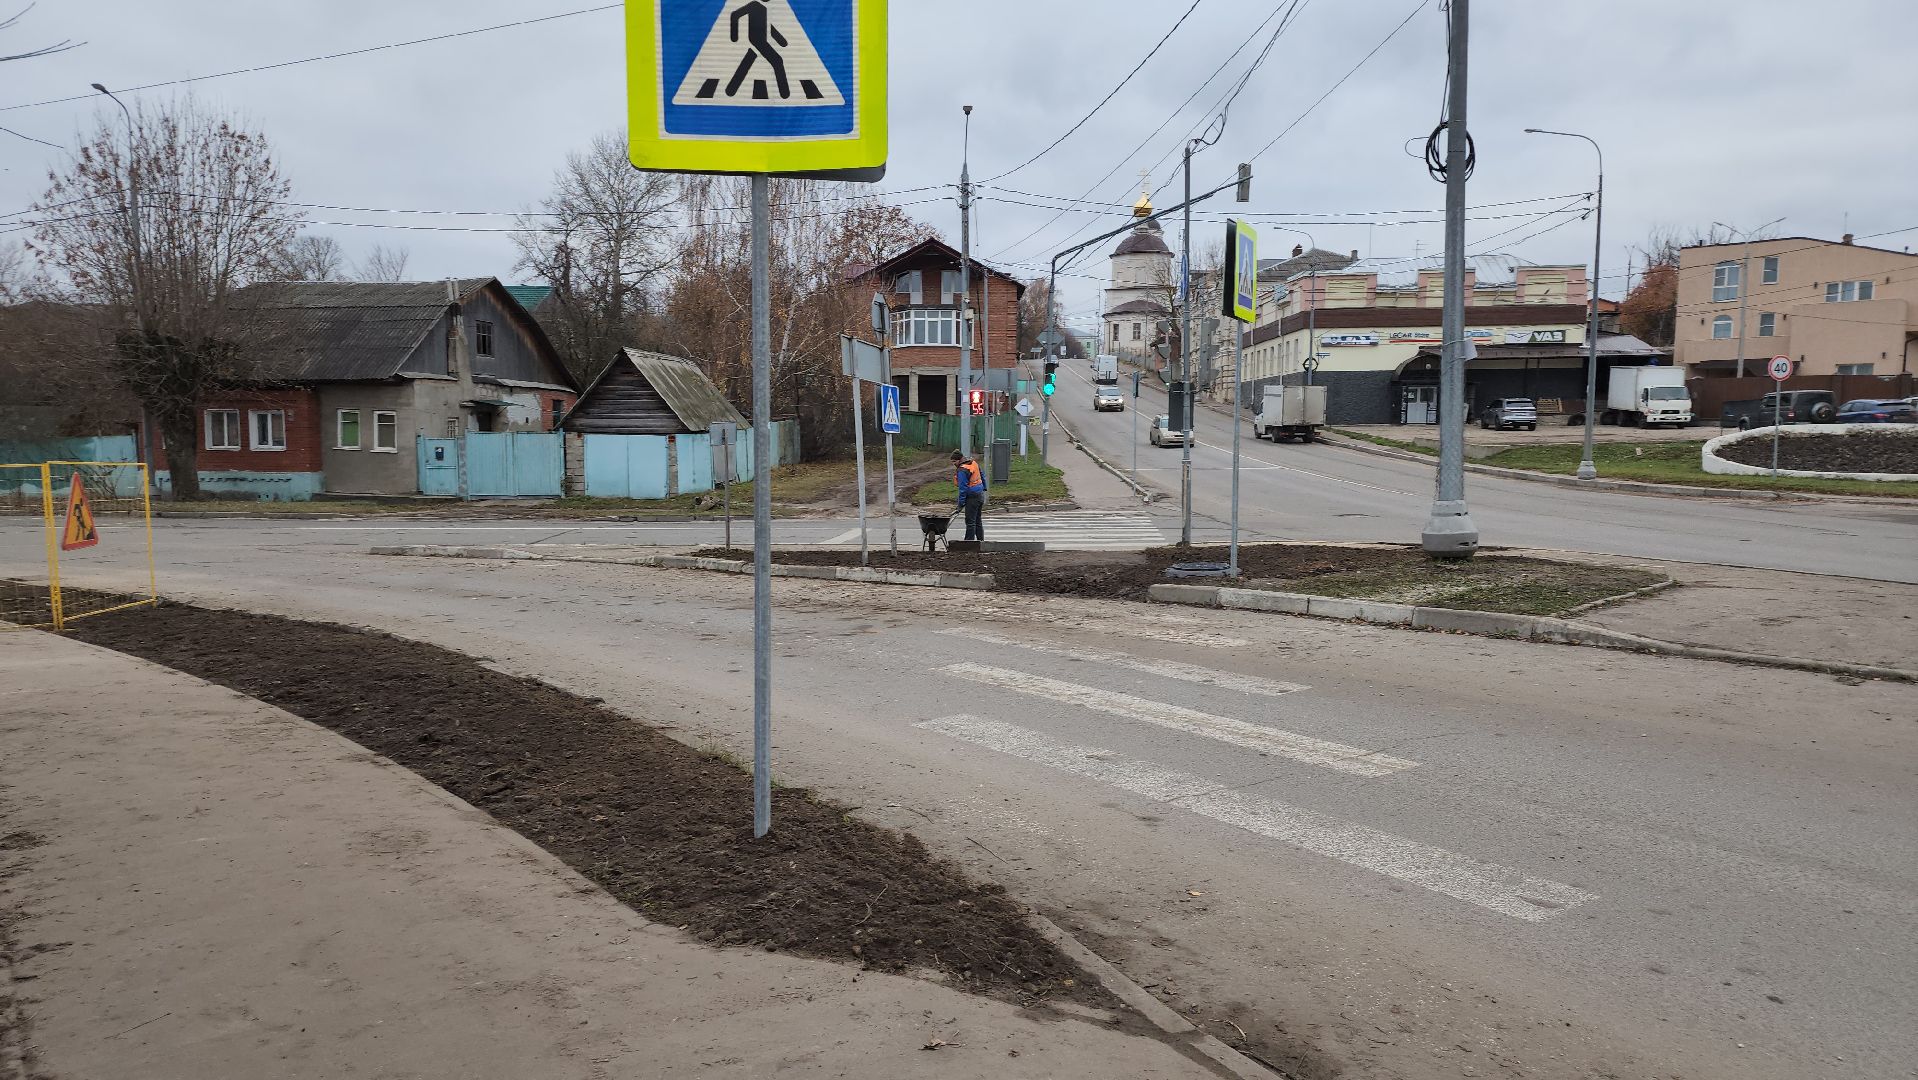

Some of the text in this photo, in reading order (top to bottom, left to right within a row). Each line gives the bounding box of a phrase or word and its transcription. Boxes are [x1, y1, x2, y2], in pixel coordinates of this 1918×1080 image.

[1534, 331, 1563, 341] УАЗ
[1774, 362, 1788, 374] 40
[971, 403, 984, 415] 55
